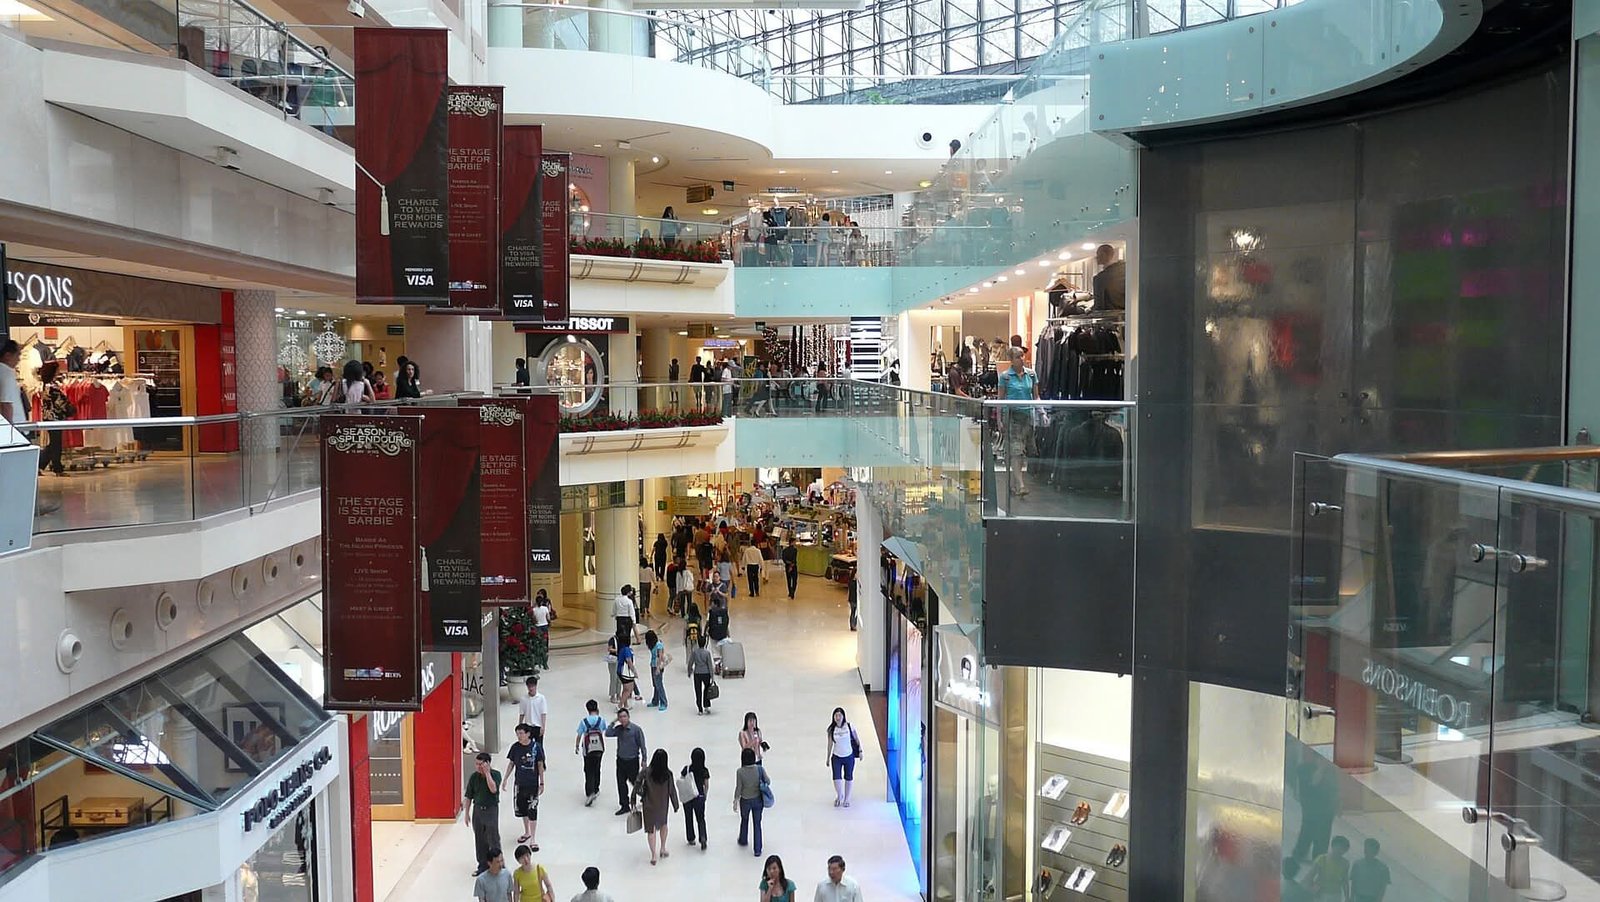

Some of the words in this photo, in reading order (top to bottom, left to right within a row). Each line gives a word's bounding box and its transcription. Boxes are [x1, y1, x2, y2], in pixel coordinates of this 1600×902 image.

[459, 148, 491, 156] STAGE
[398, 198, 439, 206] CHARGE
[394, 213, 413, 221] FOR
[415, 213, 443, 221] MORE
[405, 275, 434, 286] VISA
[7, 270, 74, 308] SONS
[514, 300, 534, 308] VISA
[568, 316, 614, 330] TISSOT
[342, 427, 386, 435] SEASON
[338, 435, 404, 443] SPLENDOUR
[337, 496, 362, 506] THE
[364, 497, 404, 506] STAGE
[338, 506, 349, 515] IS
[352, 507, 375, 516] SET
[378, 507, 404, 516] FOR
[348, 516, 394, 525] BARBIE
[532, 553, 551, 561] VISA
[436, 558, 473, 566] CHARGE
[433, 578, 476, 586] REWARDS
[444, 626, 469, 636] VISA
[242, 788, 279, 833] POLO
[278, 759, 314, 803] JEANS
